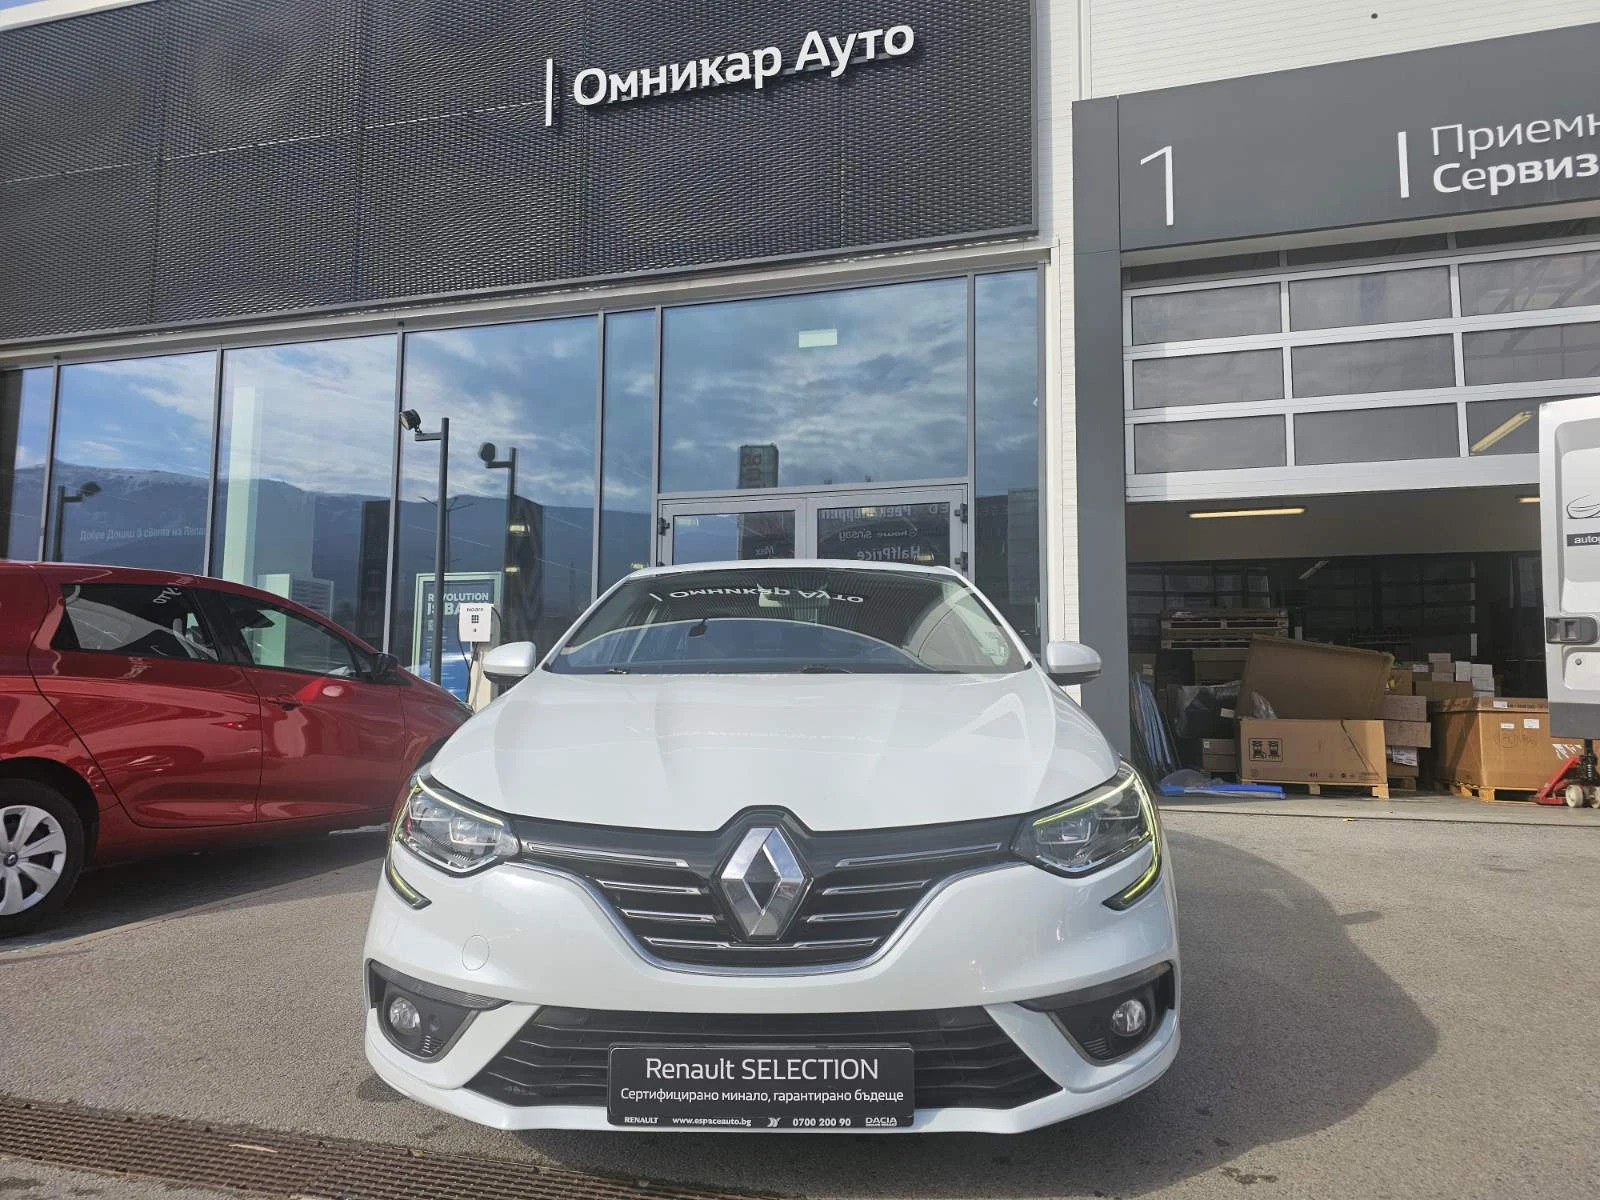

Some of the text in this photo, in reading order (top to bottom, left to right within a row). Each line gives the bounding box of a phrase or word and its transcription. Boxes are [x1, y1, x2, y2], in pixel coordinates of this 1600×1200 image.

[573, 24, 915, 107] Омникар Ауто
[1139, 145, 1176, 227] 1
[1432, 153, 1600, 196] Сервиз
[645, 1057, 880, 1081] Renault SELECTION
[620, 1087, 904, 1104] Сертифицирано минало, гарантирано бъдеще
[624, 1116, 897, 1127] RENAULT www.espaceauto.bg 0700 200 90 DACIA
